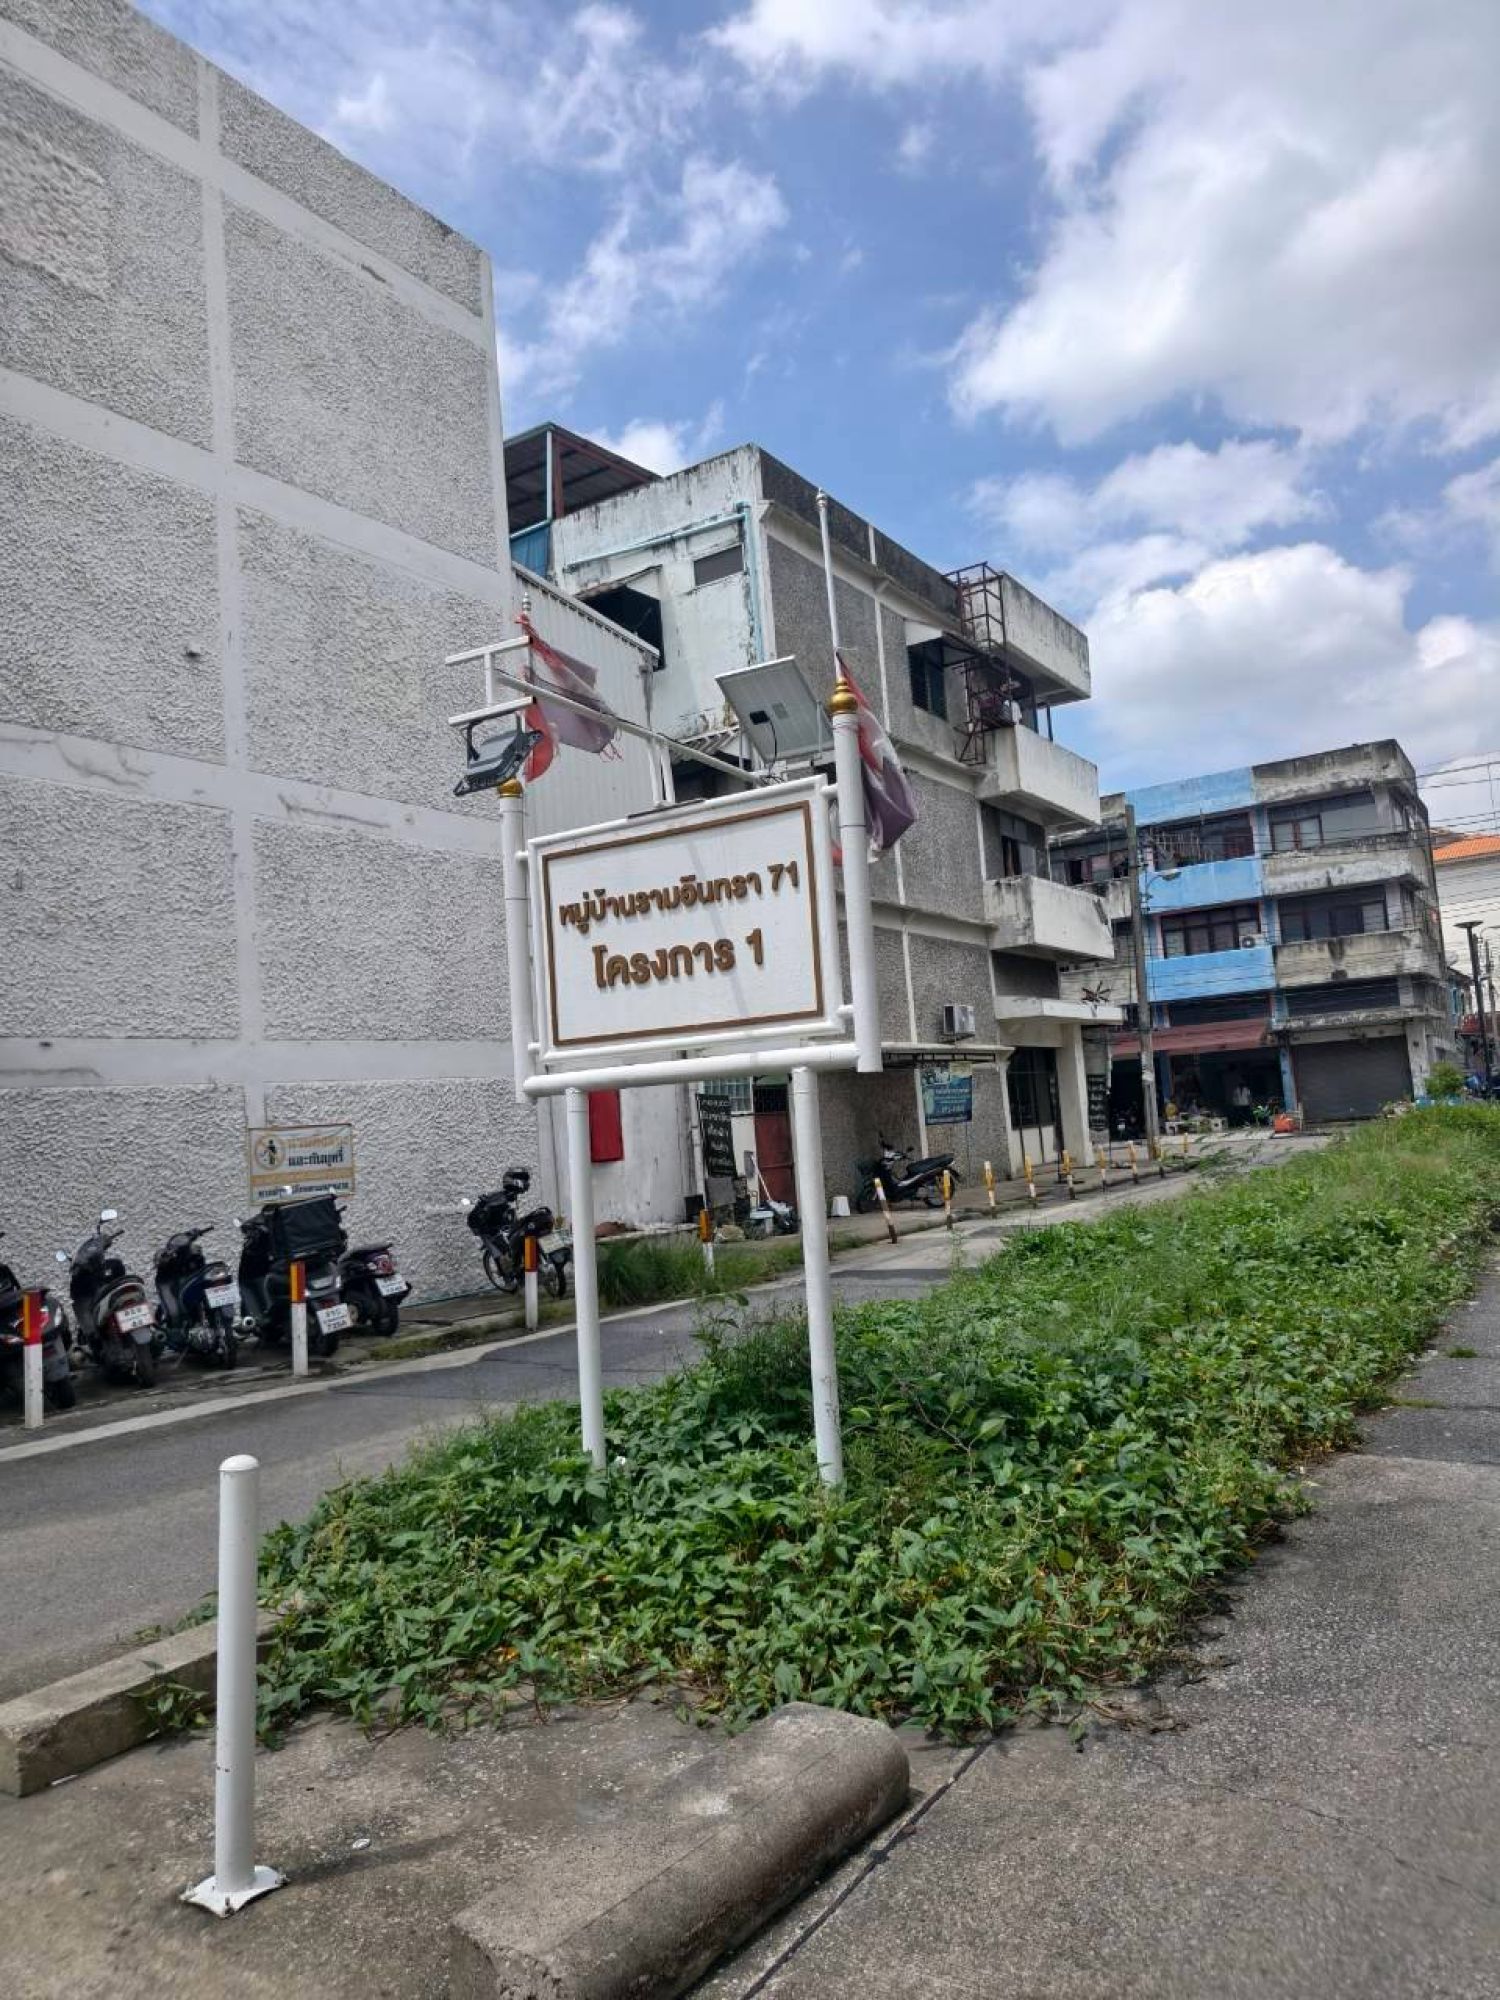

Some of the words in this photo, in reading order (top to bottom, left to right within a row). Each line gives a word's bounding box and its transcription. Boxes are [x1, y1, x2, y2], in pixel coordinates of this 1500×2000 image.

[767, 860, 798, 891] 71
[592, 938, 735, 988] โครงการ
[746, 928, 763, 965] 1
